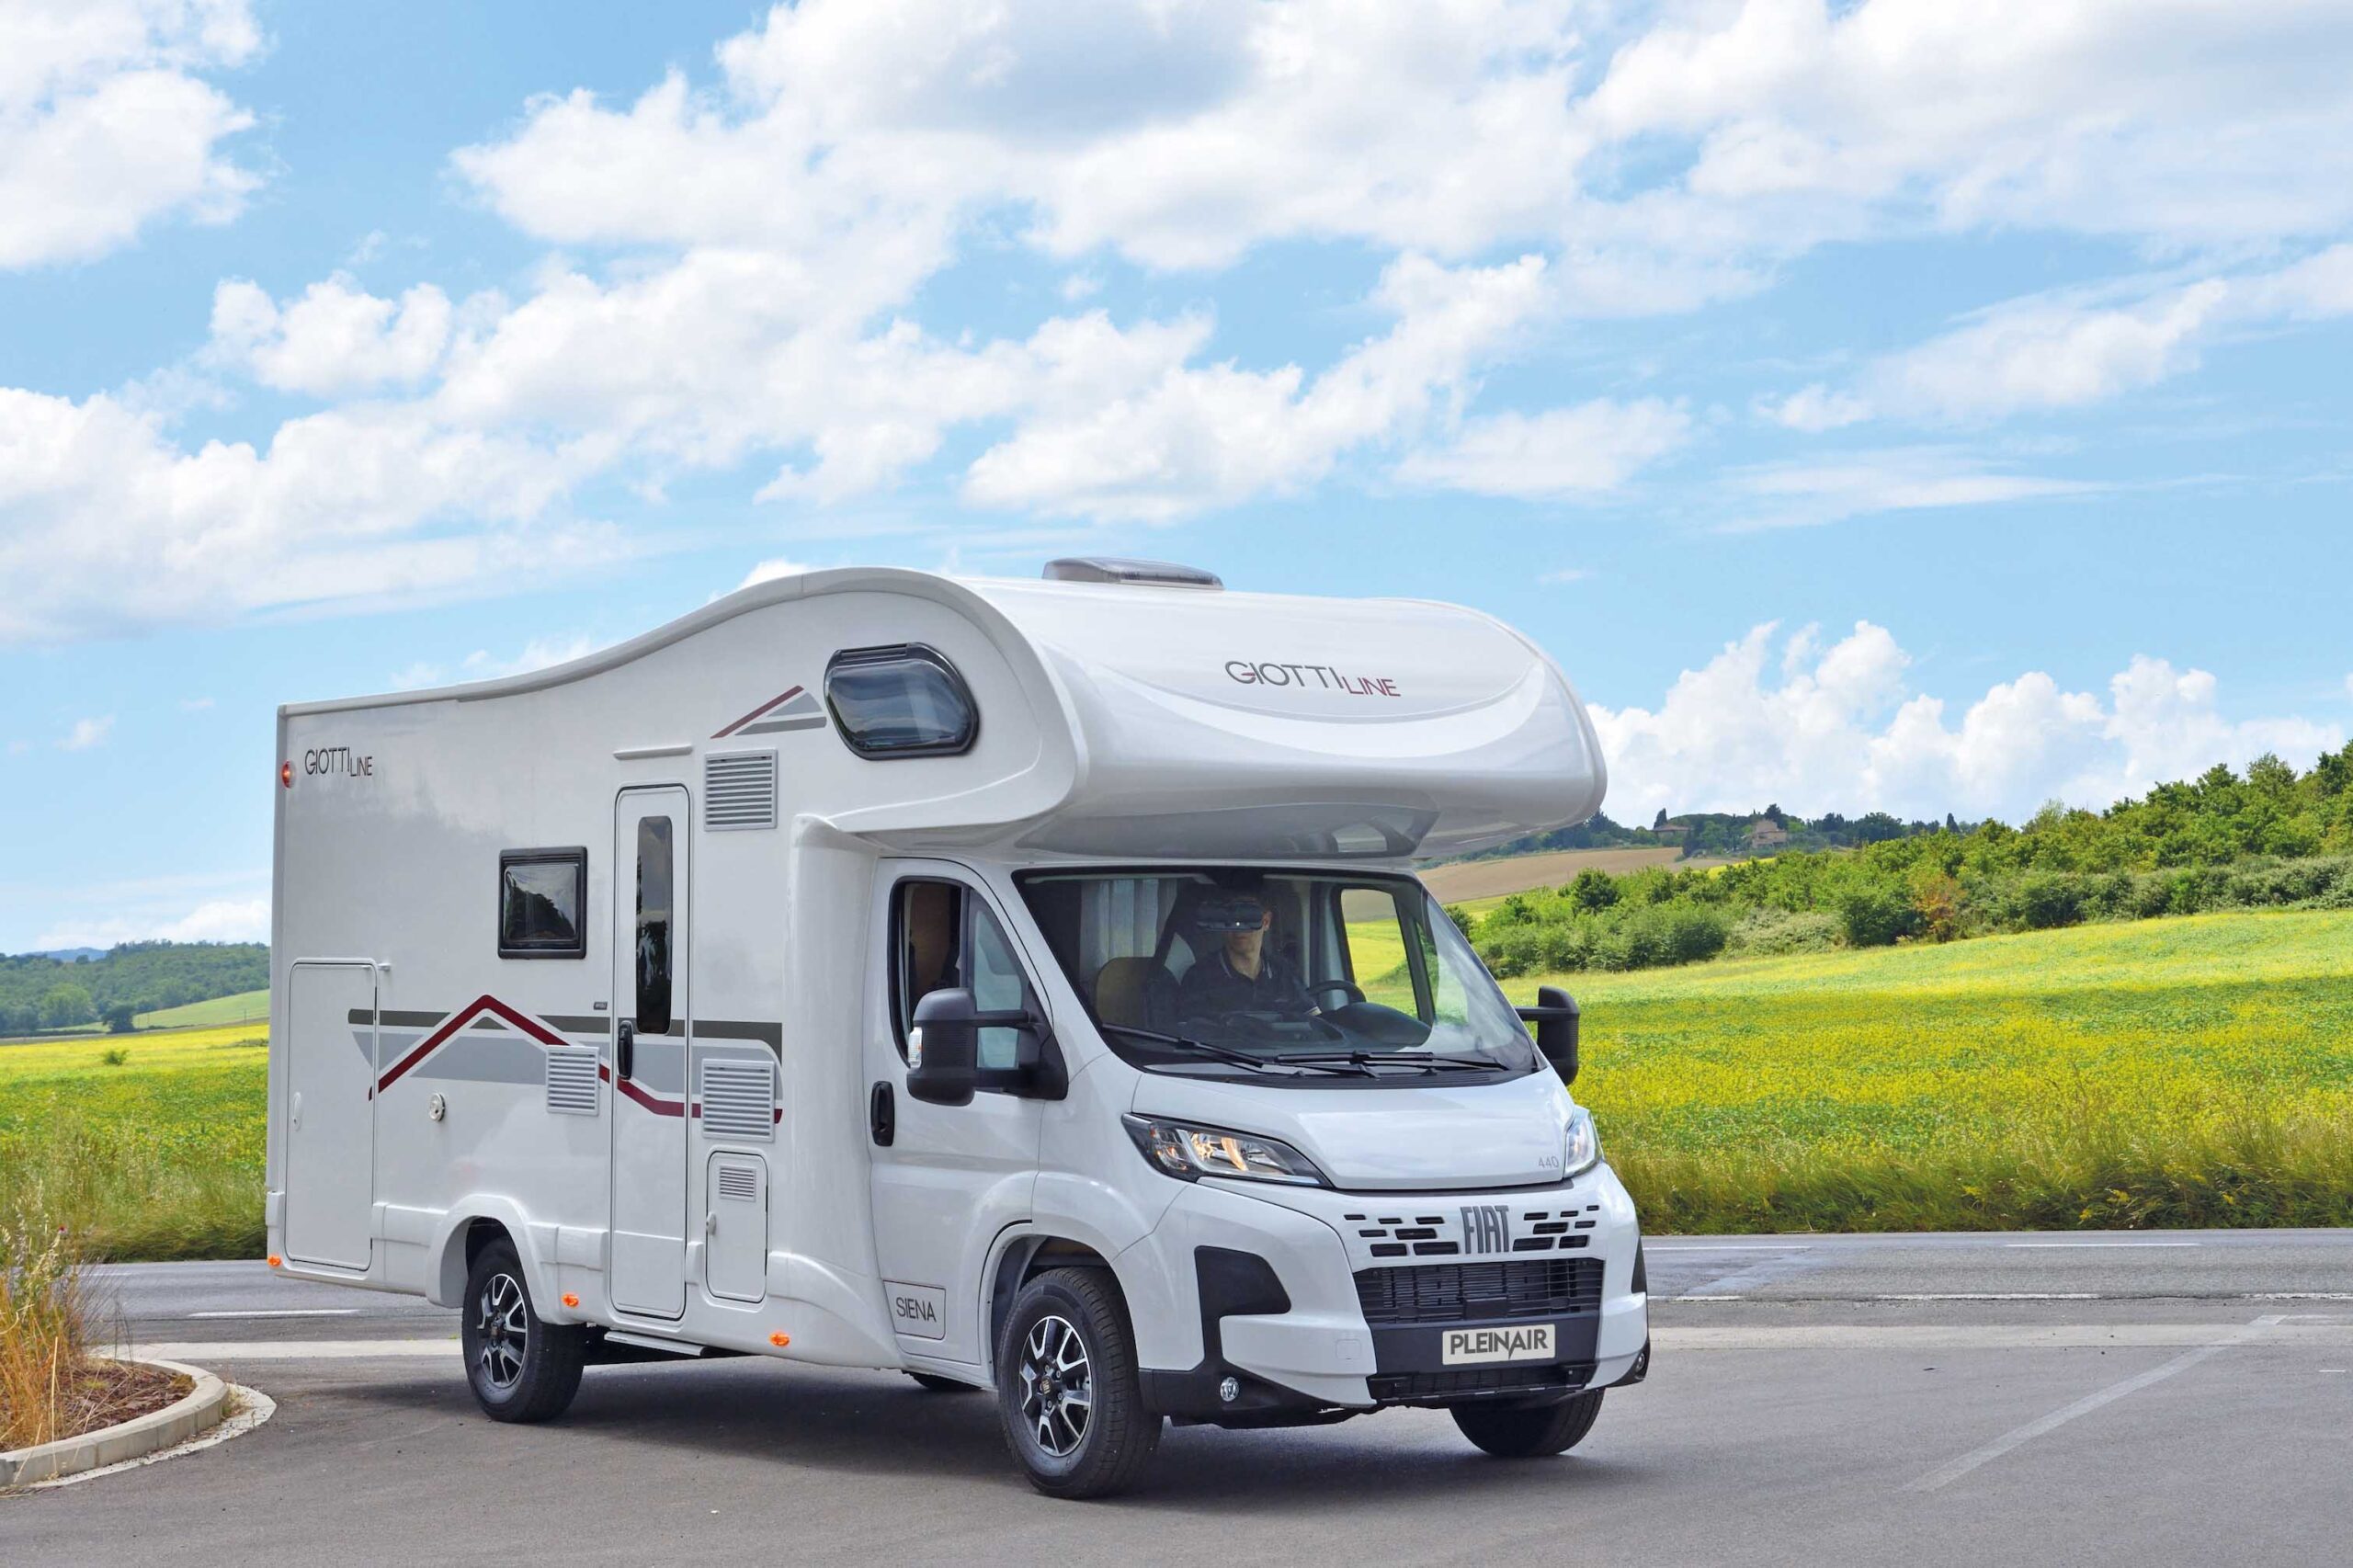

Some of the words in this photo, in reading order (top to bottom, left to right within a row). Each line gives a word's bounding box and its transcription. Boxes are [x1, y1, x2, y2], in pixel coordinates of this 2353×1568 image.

[1538, 1155, 1560, 1168] 440
[1460, 1204, 1509, 1255] FIAT
[895, 1297, 937, 1323] SIENA
[1450, 1329, 1549, 1360] PLEINAIR
